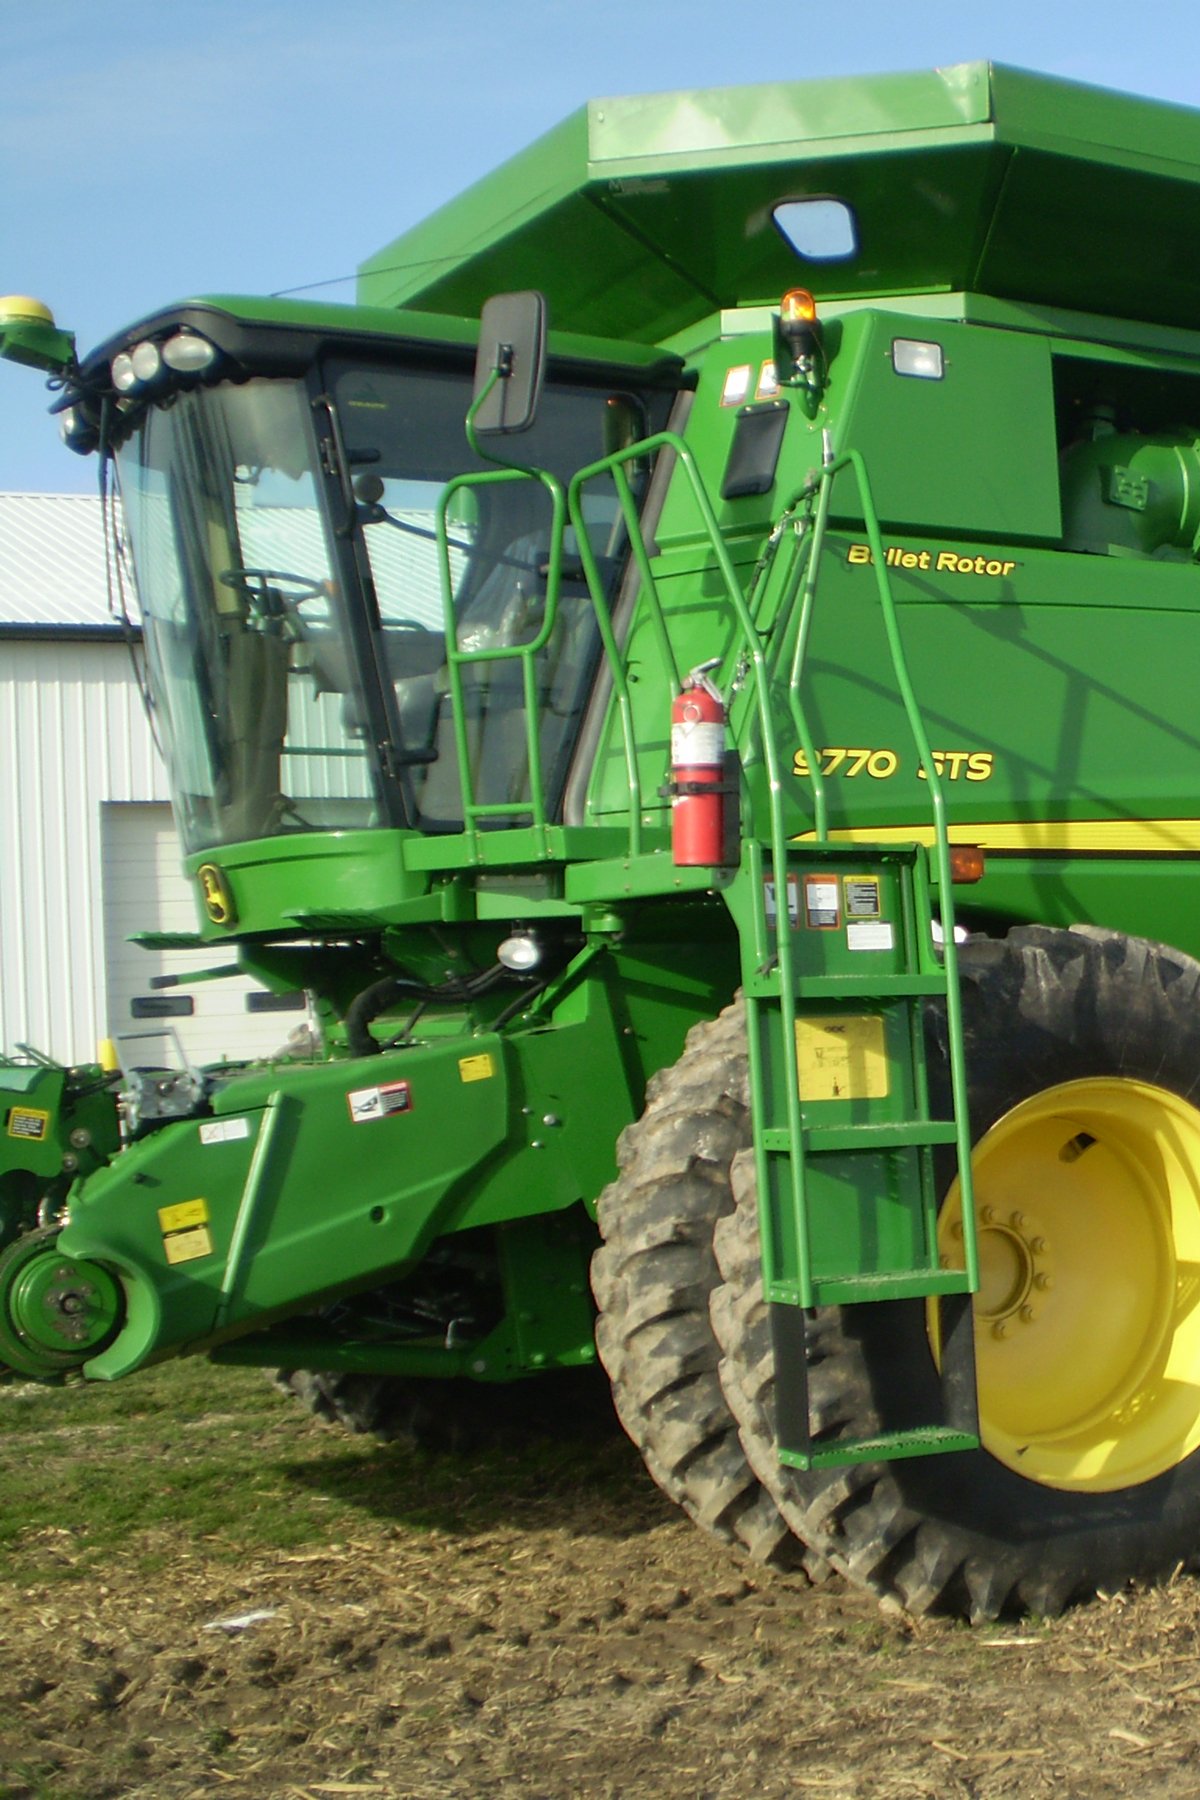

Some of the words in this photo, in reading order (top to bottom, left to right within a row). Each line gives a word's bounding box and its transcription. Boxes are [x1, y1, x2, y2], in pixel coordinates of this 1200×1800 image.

[848, 545, 931, 570] Bllet
[936, 552, 1015, 576] Rotor
[792, 748, 898, 778] 9770
[917, 751, 994, 781] STS
